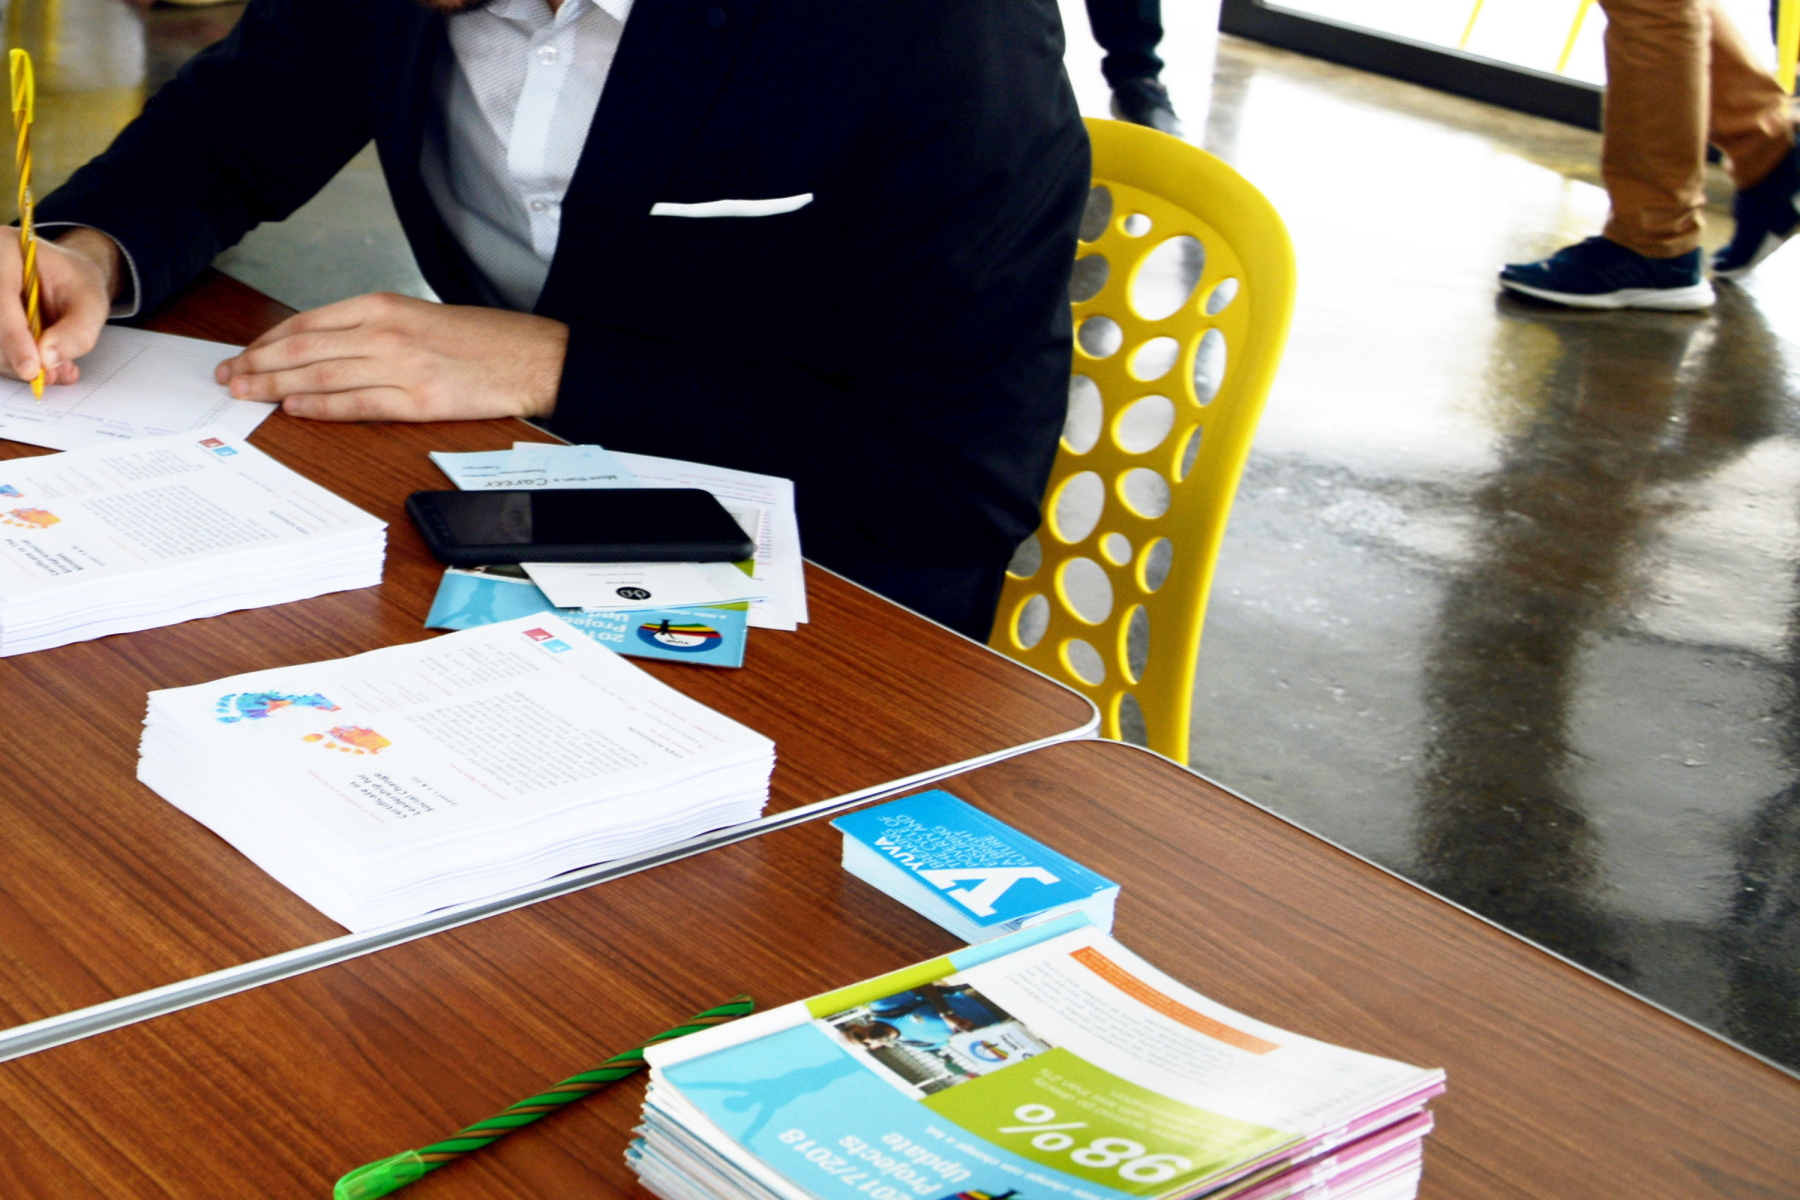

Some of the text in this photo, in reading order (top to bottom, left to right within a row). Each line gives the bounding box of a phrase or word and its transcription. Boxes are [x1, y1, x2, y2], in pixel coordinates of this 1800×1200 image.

[484, 477, 548, 488] Career
[353, 772, 374, 785] for
[370, 770, 410, 796] Change
[346, 780, 409, 820] Certificate in
[367, 781, 422, 816] Leadership
[402, 793, 436, 813] Social
[873, 835, 925, 872] YUVA
[876, 814, 959, 869] THE CYCLE OF
[880, 827, 943, 870] BREAKING
[895, 813, 977, 868] POVERTY AND
[934, 824, 997, 867] ENSURING
[952, 828, 1002, 861] BRIGHT
[980, 834, 1033, 866] FUTURE
[880, 1132, 972, 1184] Update
[955, 1141, 1001, 1166] change
[997, 1102, 1193, 1184] 98%
[837, 1134, 944, 1196] Projects
